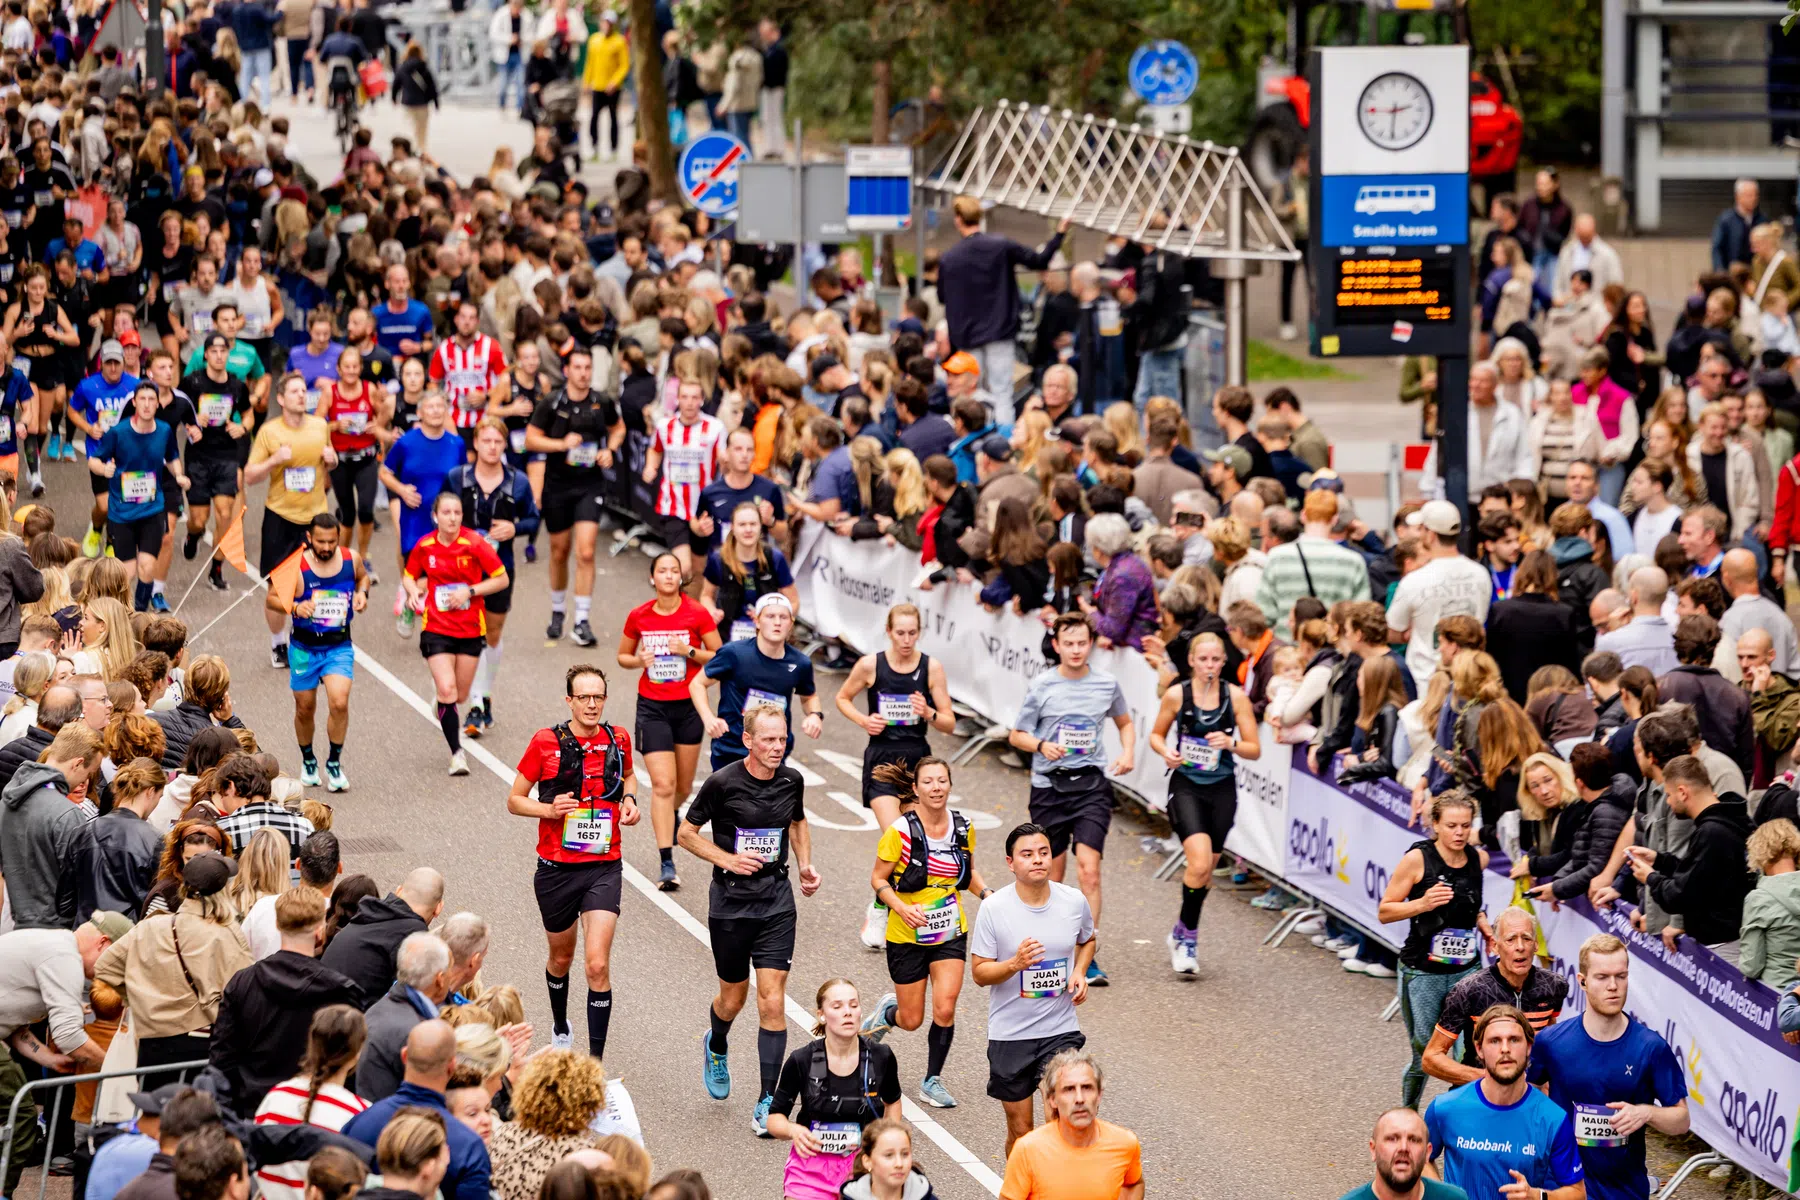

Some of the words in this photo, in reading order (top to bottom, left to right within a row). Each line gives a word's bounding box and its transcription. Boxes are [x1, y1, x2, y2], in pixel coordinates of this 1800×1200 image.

[577, 822, 602, 830] BRAM
[577, 831, 601, 841] 1657
[744, 837, 776, 845] PETER
[1290, 816, 1334, 876] apollo
[924, 909, 953, 921] SARAH
[928, 919, 951, 931] 1827
[1033, 970, 1059, 980] JUAN
[1030, 979, 1061, 990] 13424
[1695, 968, 1710, 995] op
[1707, 976, 1775, 1031] apolloreizen.nl
[1581, 1116, 1610, 1126] MAUR
[1720, 1081, 1787, 1163] apollo
[820, 1133, 848, 1141] JULIA
[1584, 1126, 1619, 1137] 21294
[1456, 1136, 1512, 1155] Rabobank
